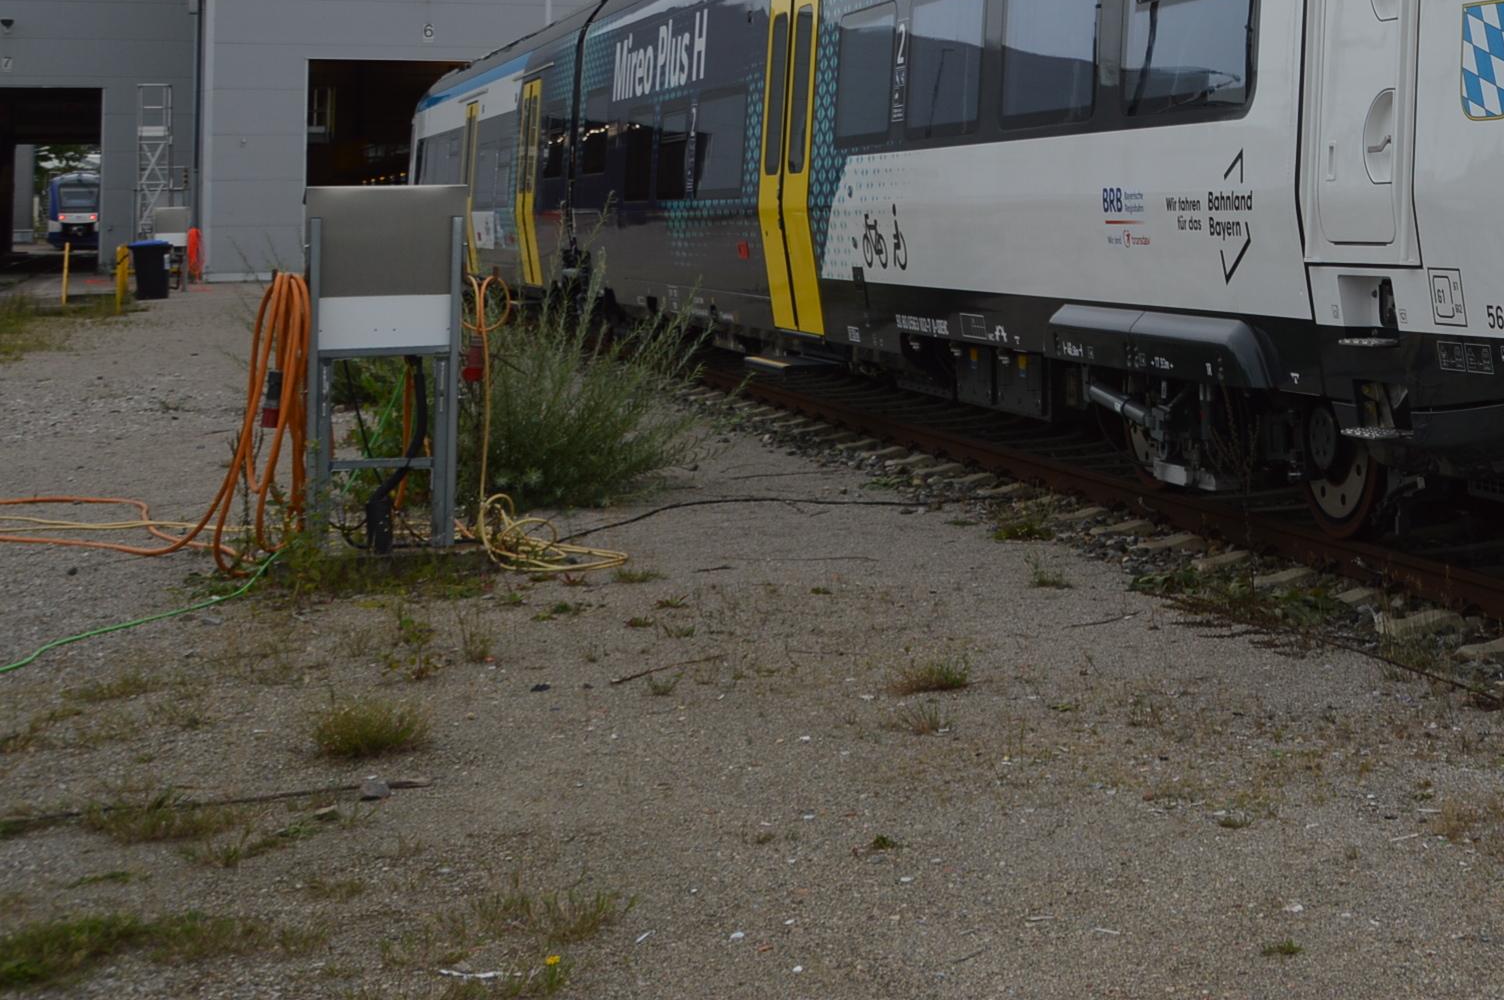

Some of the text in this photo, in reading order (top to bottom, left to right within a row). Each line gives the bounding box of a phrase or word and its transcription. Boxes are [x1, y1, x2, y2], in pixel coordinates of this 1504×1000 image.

[423, 23, 434, 38] 6
[897, 23, 906, 64] 2
[3, 55, 13, 68] 7
[612, 8, 708, 102] Mireo Plus H
[1103, 187, 1123, 213] BRB
[1165, 197, 1201, 212] Wir fahren
[1208, 190, 1253, 212] Bahnland
[1188, 216, 1202, 231] das
[1209, 216, 1242, 241] Bayern
